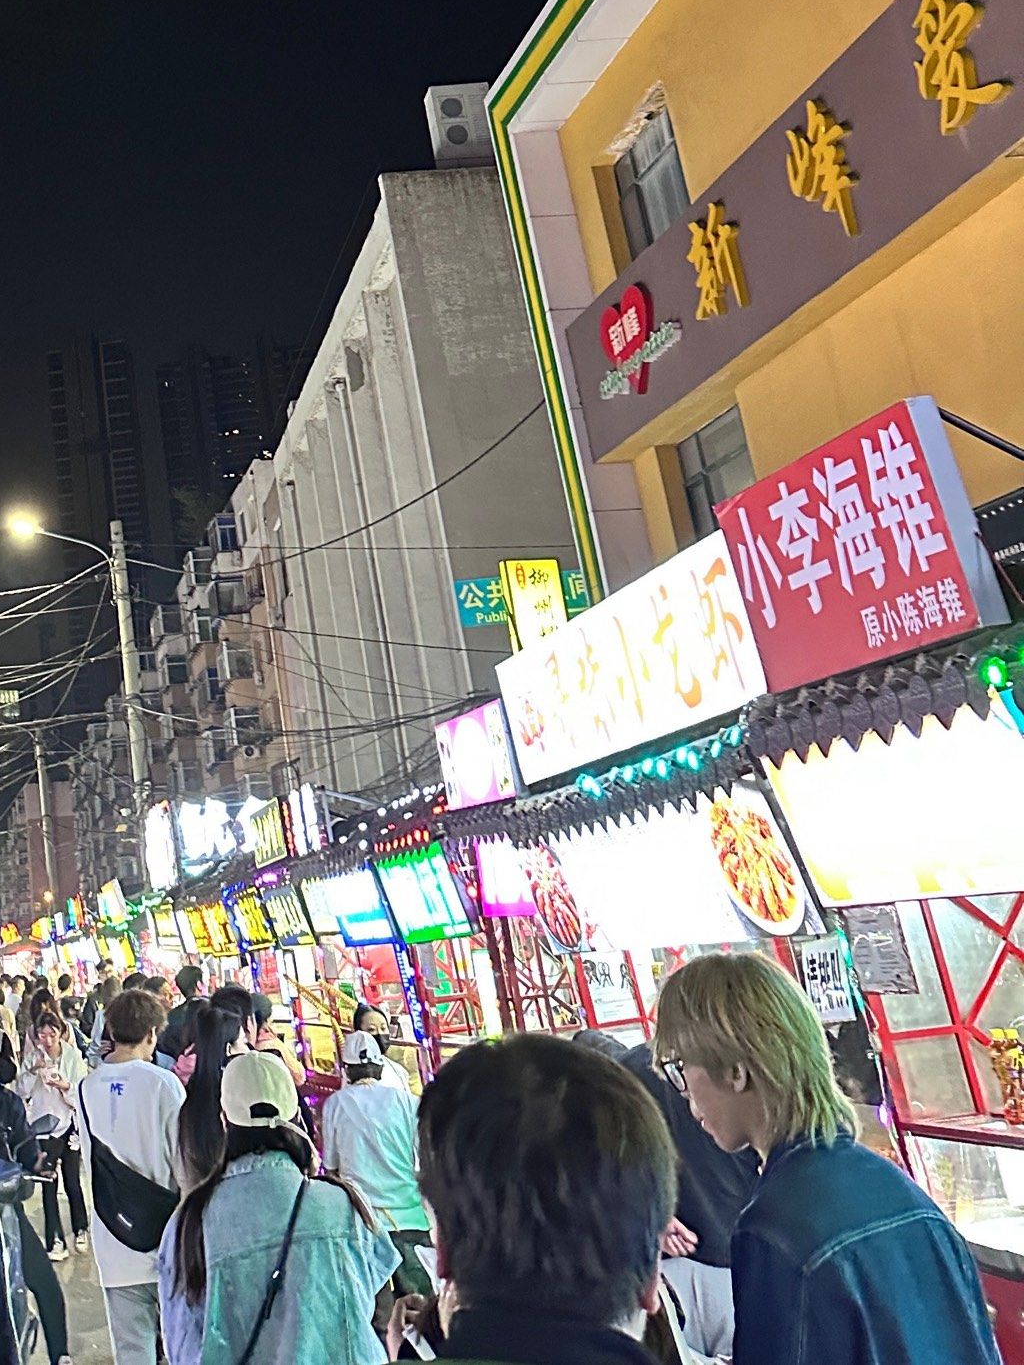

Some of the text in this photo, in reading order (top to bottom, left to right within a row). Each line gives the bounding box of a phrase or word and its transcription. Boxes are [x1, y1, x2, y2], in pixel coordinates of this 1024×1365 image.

[737, 421, 948, 629] 小李海锥
[859, 577, 967, 649] 原小陈海锥
